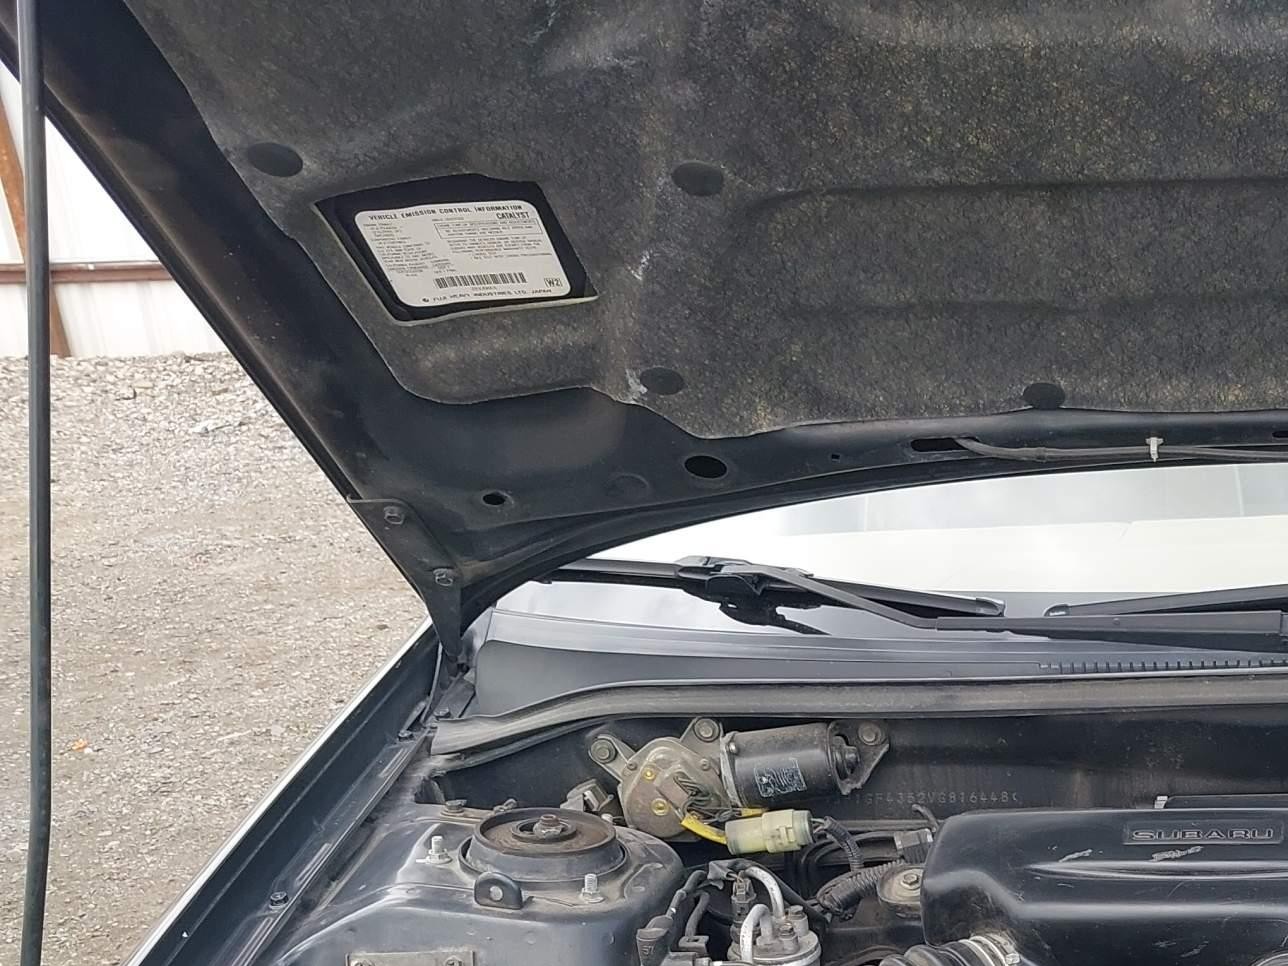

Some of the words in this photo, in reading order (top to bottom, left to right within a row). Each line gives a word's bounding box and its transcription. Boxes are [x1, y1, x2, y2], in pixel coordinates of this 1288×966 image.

[400, 209, 437, 219] EMISSION
[474, 205, 523, 213] INFORMATION
[1131, 828, 1274, 841] SUBARU
